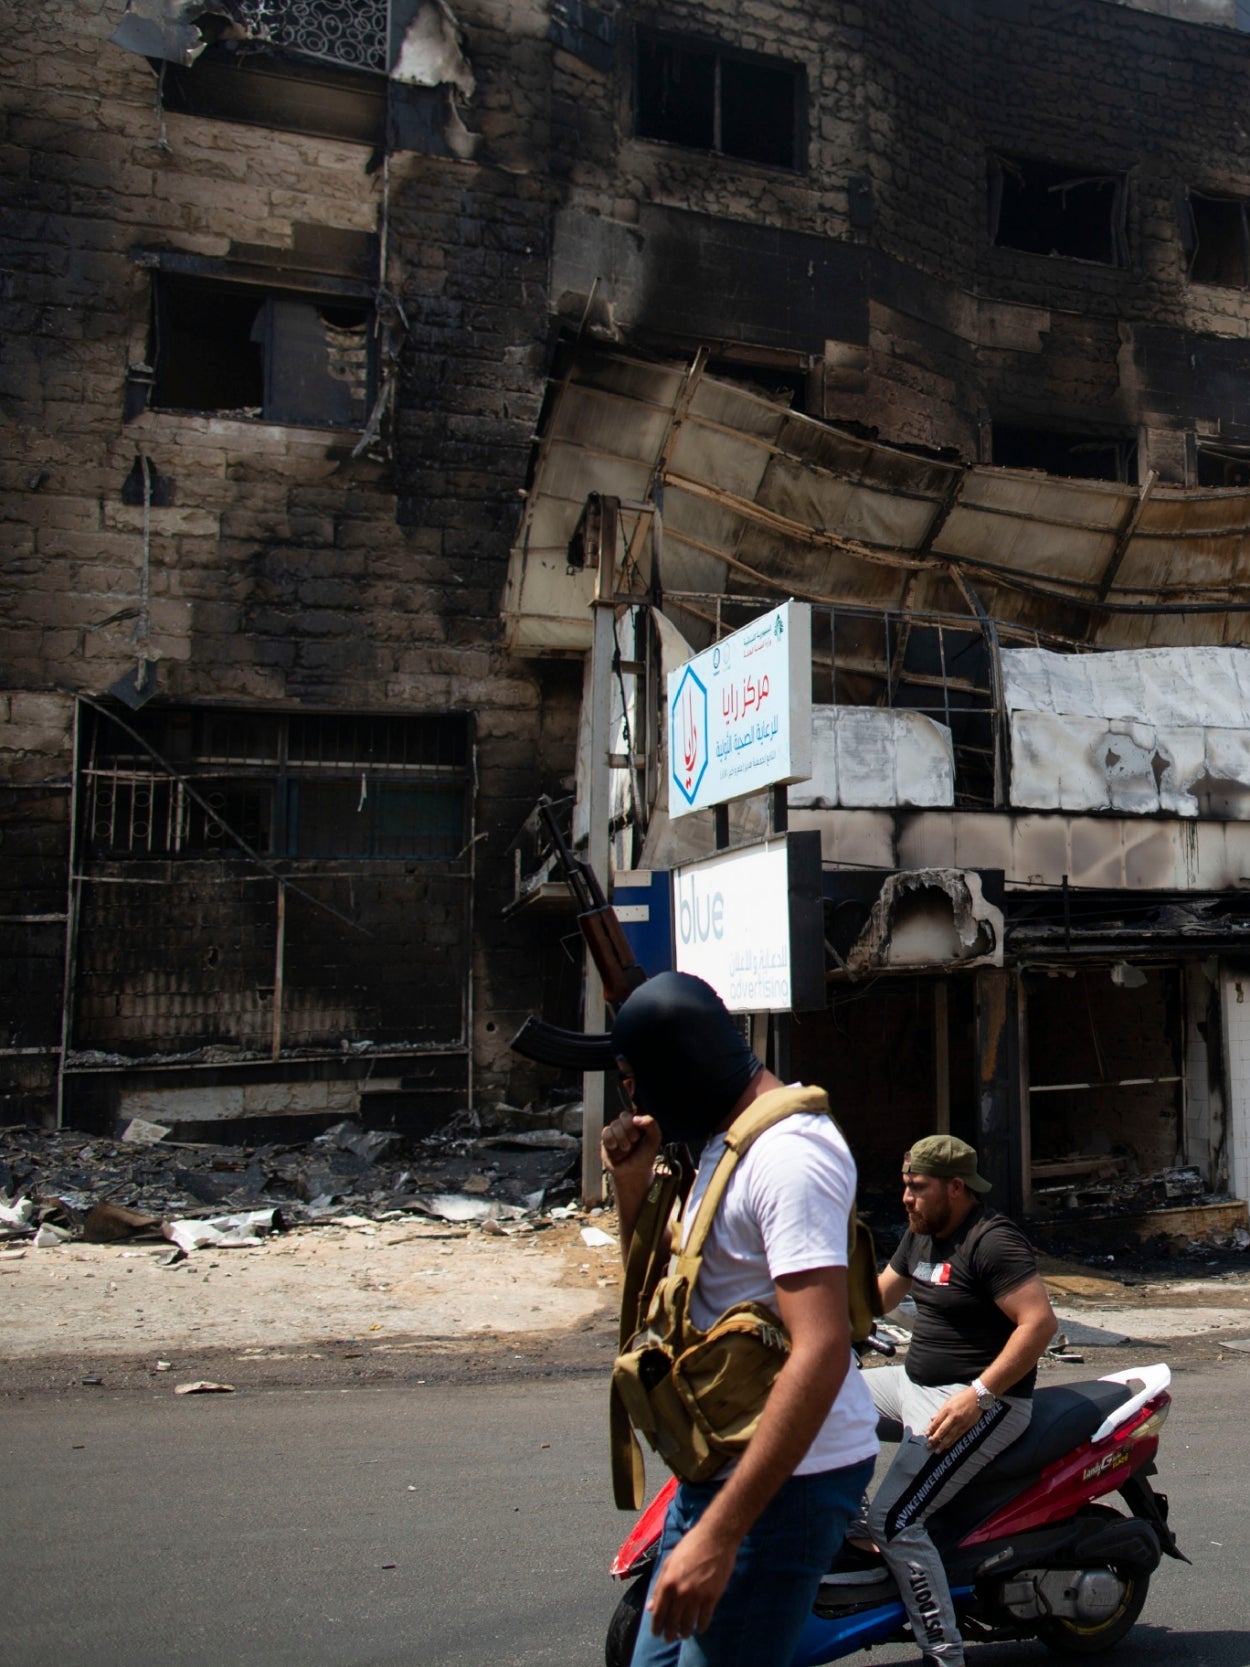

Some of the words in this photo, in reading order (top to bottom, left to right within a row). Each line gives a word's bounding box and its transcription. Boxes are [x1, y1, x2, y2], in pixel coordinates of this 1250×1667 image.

[722, 683, 739, 725] رايا
[741, 674, 770, 718] مركز
[733, 725, 755, 755] الصحية
[757, 713, 778, 746] للرعاية
[678, 868, 724, 944] blue
[730, 974, 789, 1005] advertising
[915, 1589, 937, 1614] DO
[921, 1612, 945, 1645] JUST
